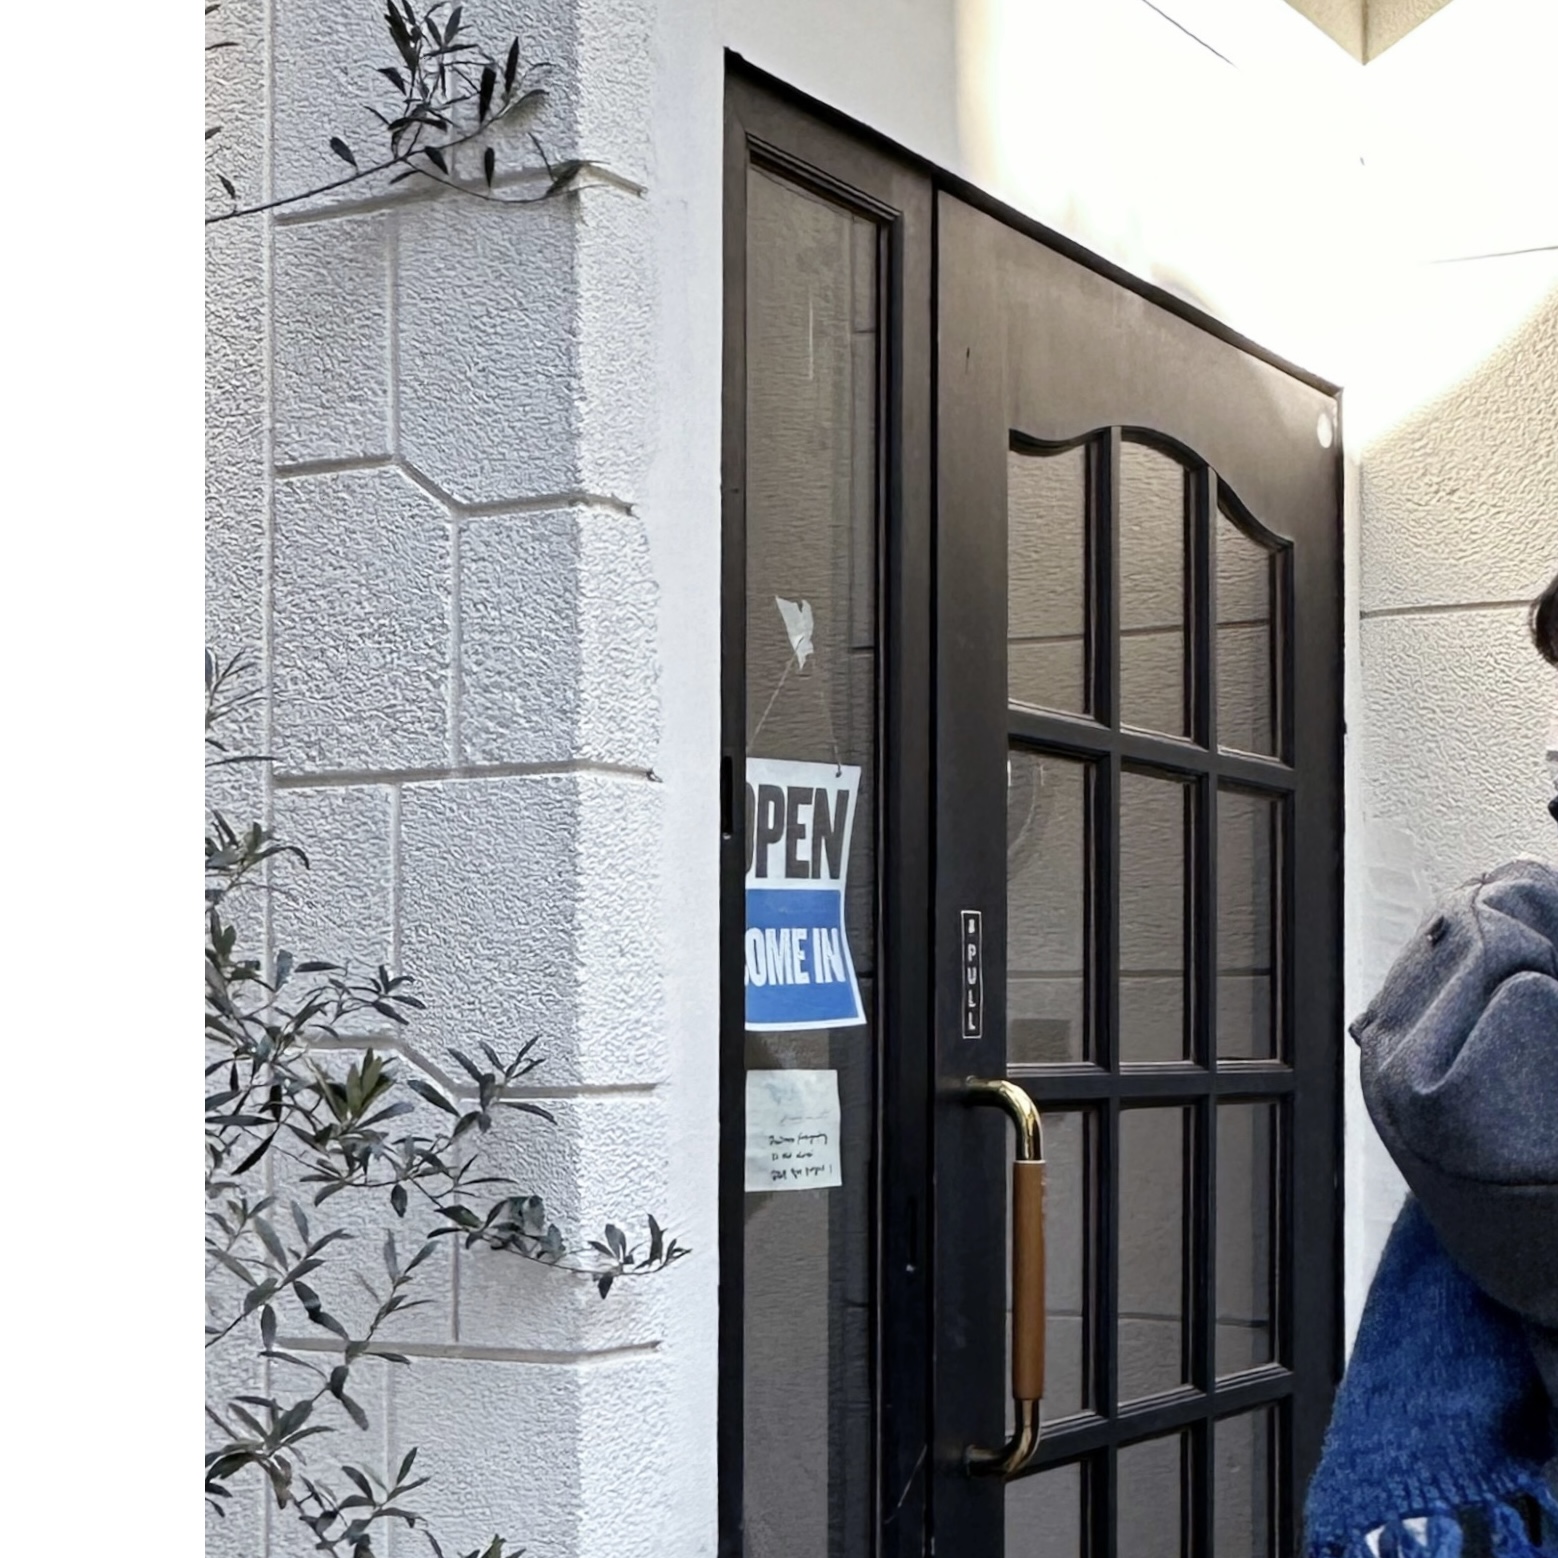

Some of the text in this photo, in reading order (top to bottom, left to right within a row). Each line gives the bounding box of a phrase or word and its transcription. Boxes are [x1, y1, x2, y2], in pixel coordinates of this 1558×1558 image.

[744, 926, 847, 987] OME IN
[966, 943, 978, 1031] PULL
